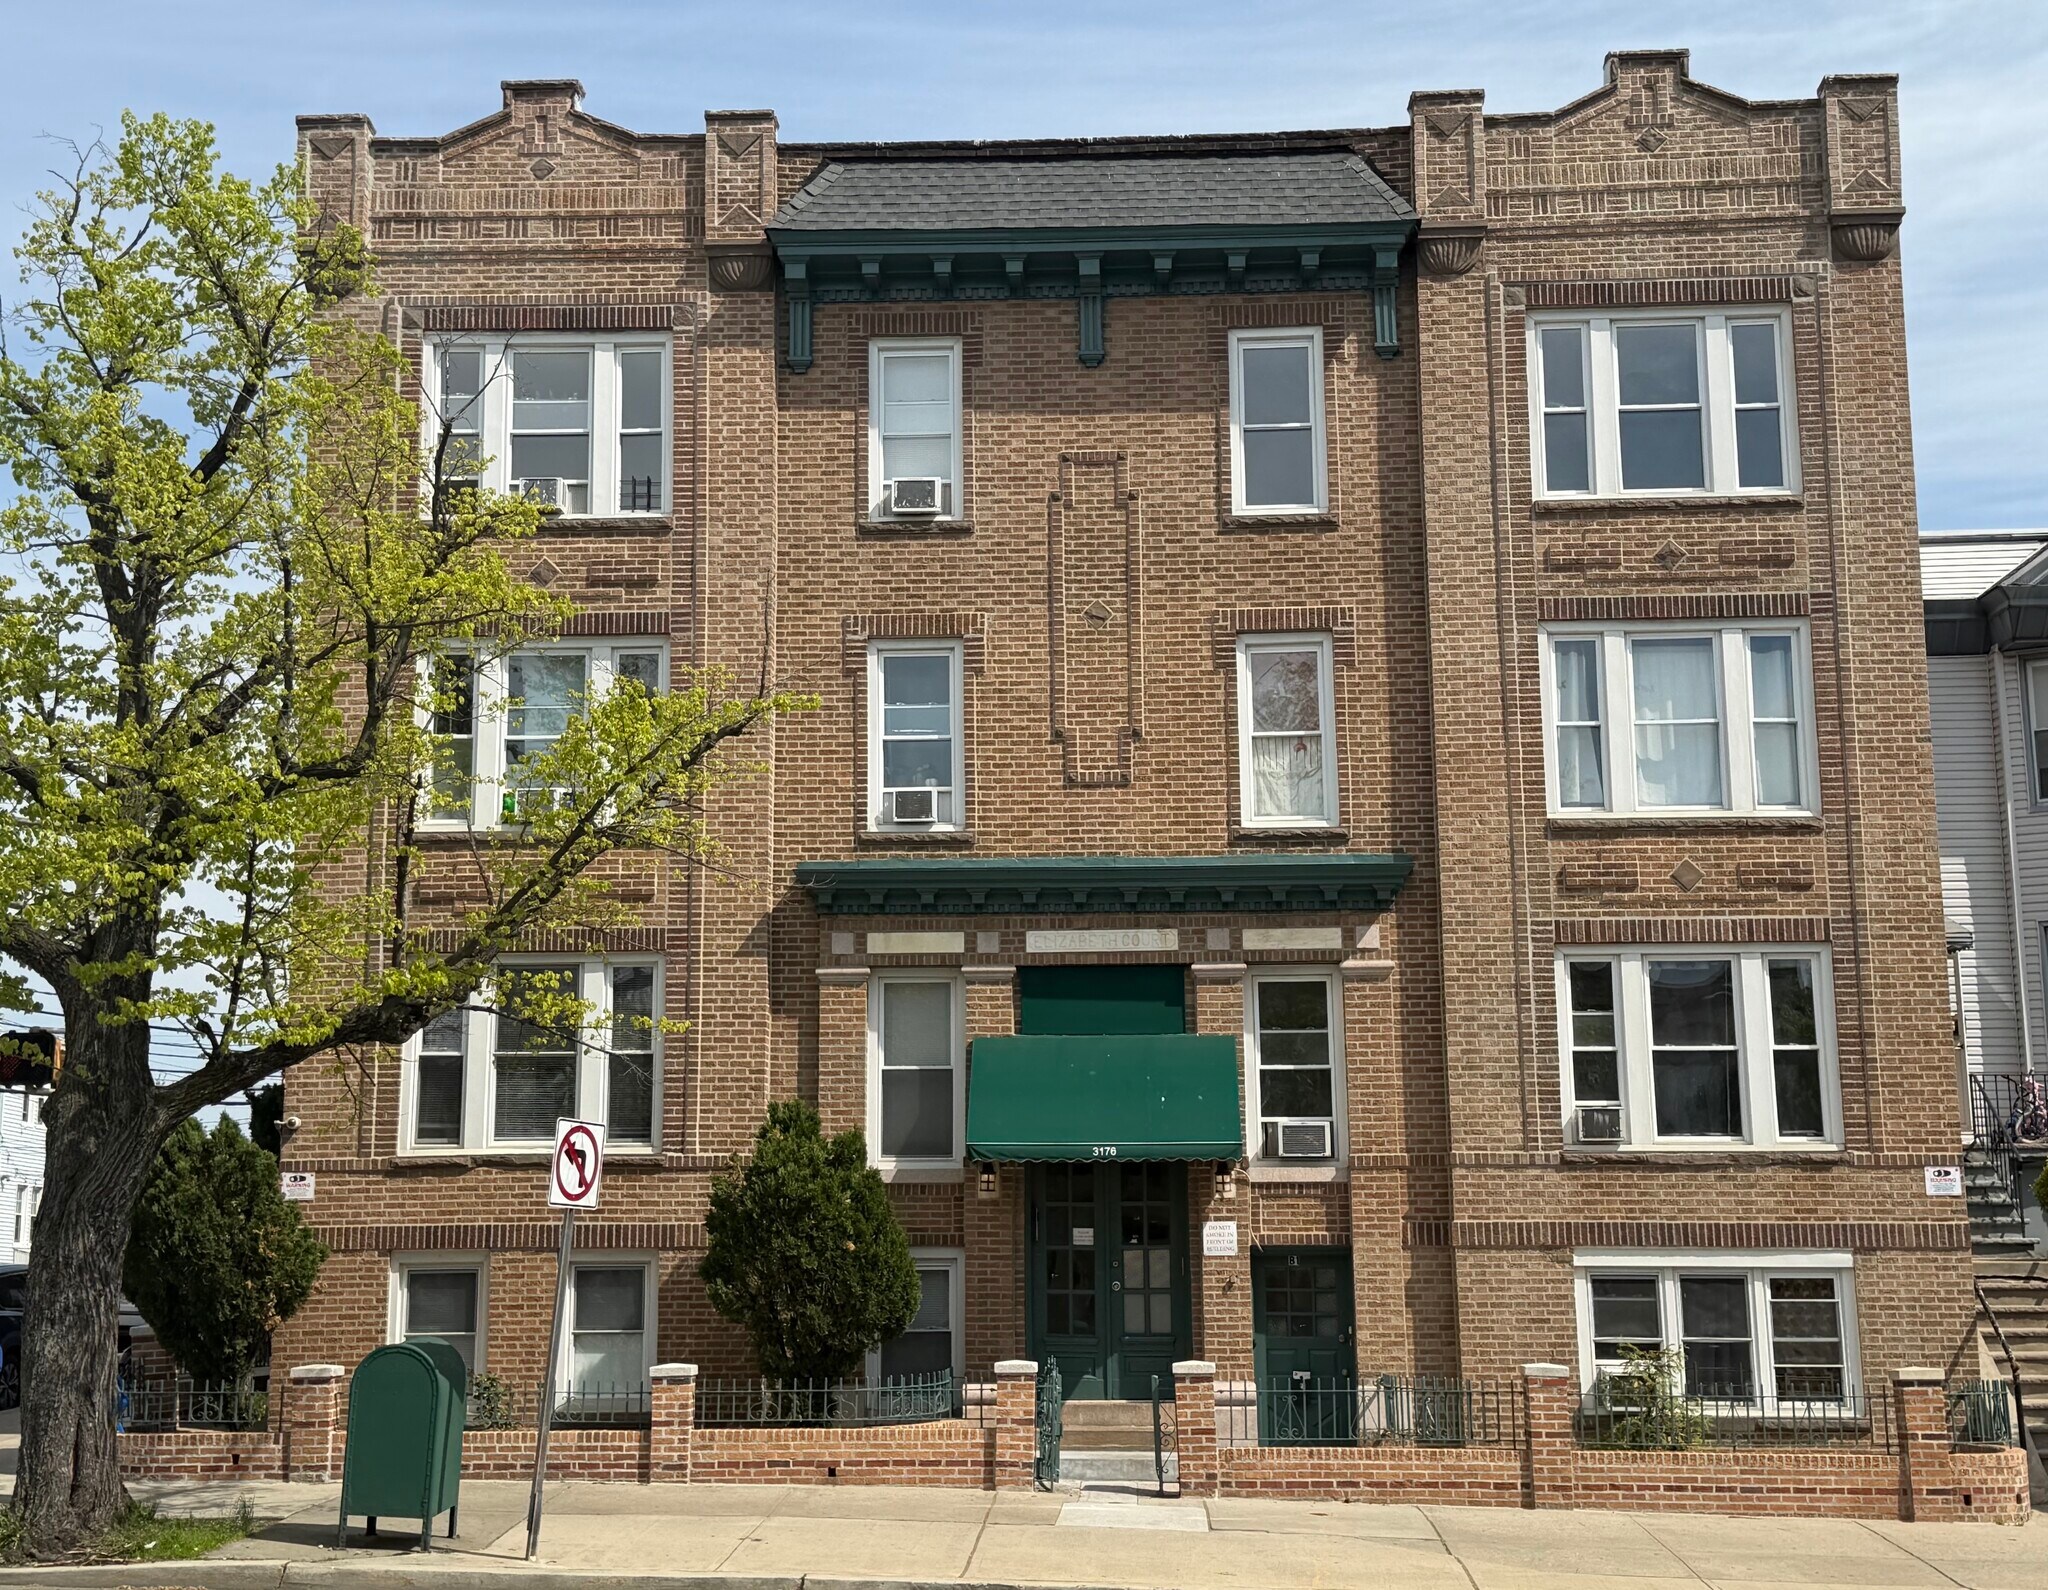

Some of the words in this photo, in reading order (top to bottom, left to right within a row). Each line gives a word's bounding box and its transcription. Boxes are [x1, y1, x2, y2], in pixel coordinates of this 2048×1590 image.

[1033, 933, 1118, 949] ELIZABETH
[1121, 932, 1171, 948] COURT
[1092, 1146, 1117, 1156] 3176
